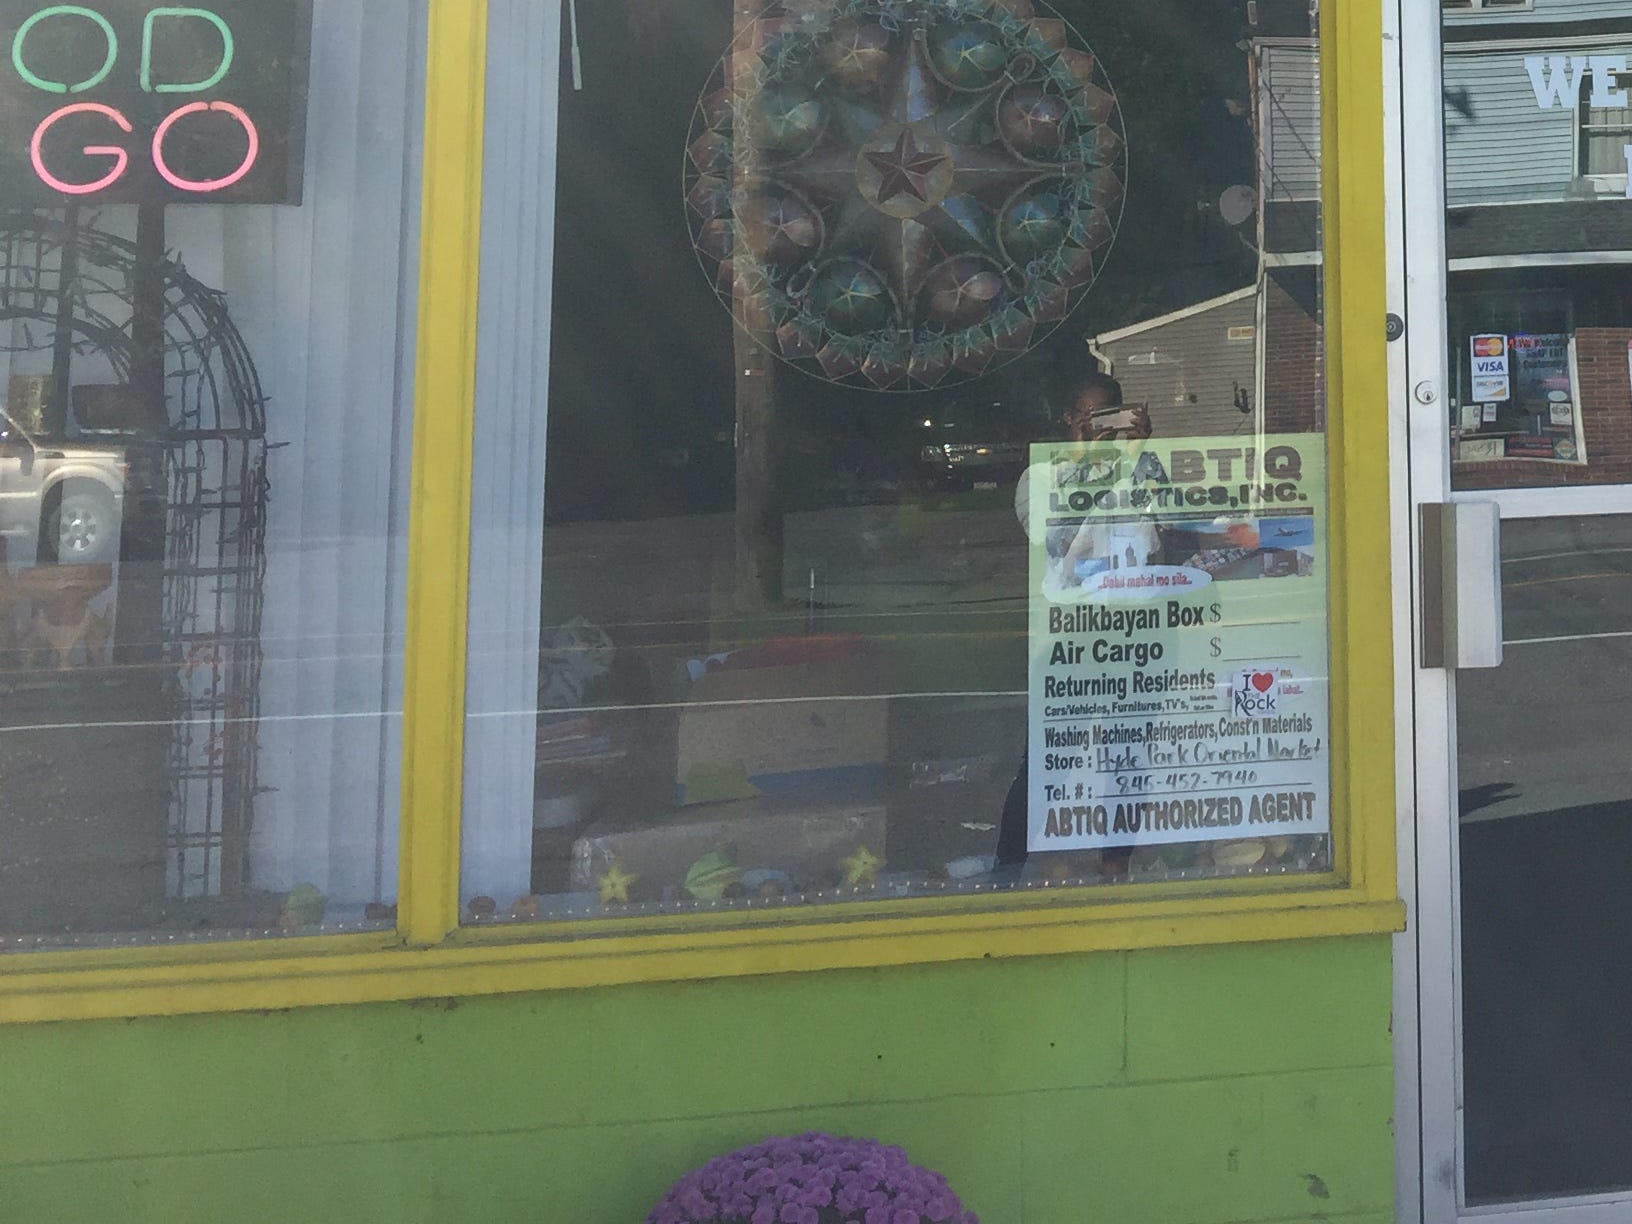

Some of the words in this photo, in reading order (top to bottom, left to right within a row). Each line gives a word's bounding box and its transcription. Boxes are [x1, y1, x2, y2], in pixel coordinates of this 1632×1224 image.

[1524, 56, 1628, 109] WE
[30, 101, 259, 194] GO
[1477, 361, 1504, 372] VISA
[1132, 446, 1303, 485] ABTIQ
[1049, 603, 1160, 637] Balikbayan
[1167, 600, 1205, 627] Box
[1210, 602, 1222, 623] $
[1050, 641, 1085, 665] Air
[1092, 638, 1164, 667] Cargo
[1210, 636, 1222, 657] $
[1044, 673, 1127, 700] Returning
[1133, 668, 1216, 695] Residents
[1044, 727, 1089, 751] Washing
[1262, 712, 1312, 733] Materials
[1096, 745, 1141, 775] Hyde
[1147, 742, 1190, 766] Park
[1193, 737, 1262, 763] Oriental
[1267, 737, 1321, 761] Market
[1044, 784, 1071, 801] Tel.
[1044, 803, 1108, 838] ABTIQ
[1113, 795, 1243, 834] AUTHORIZED
[1248, 791, 1316, 825] AGENT
